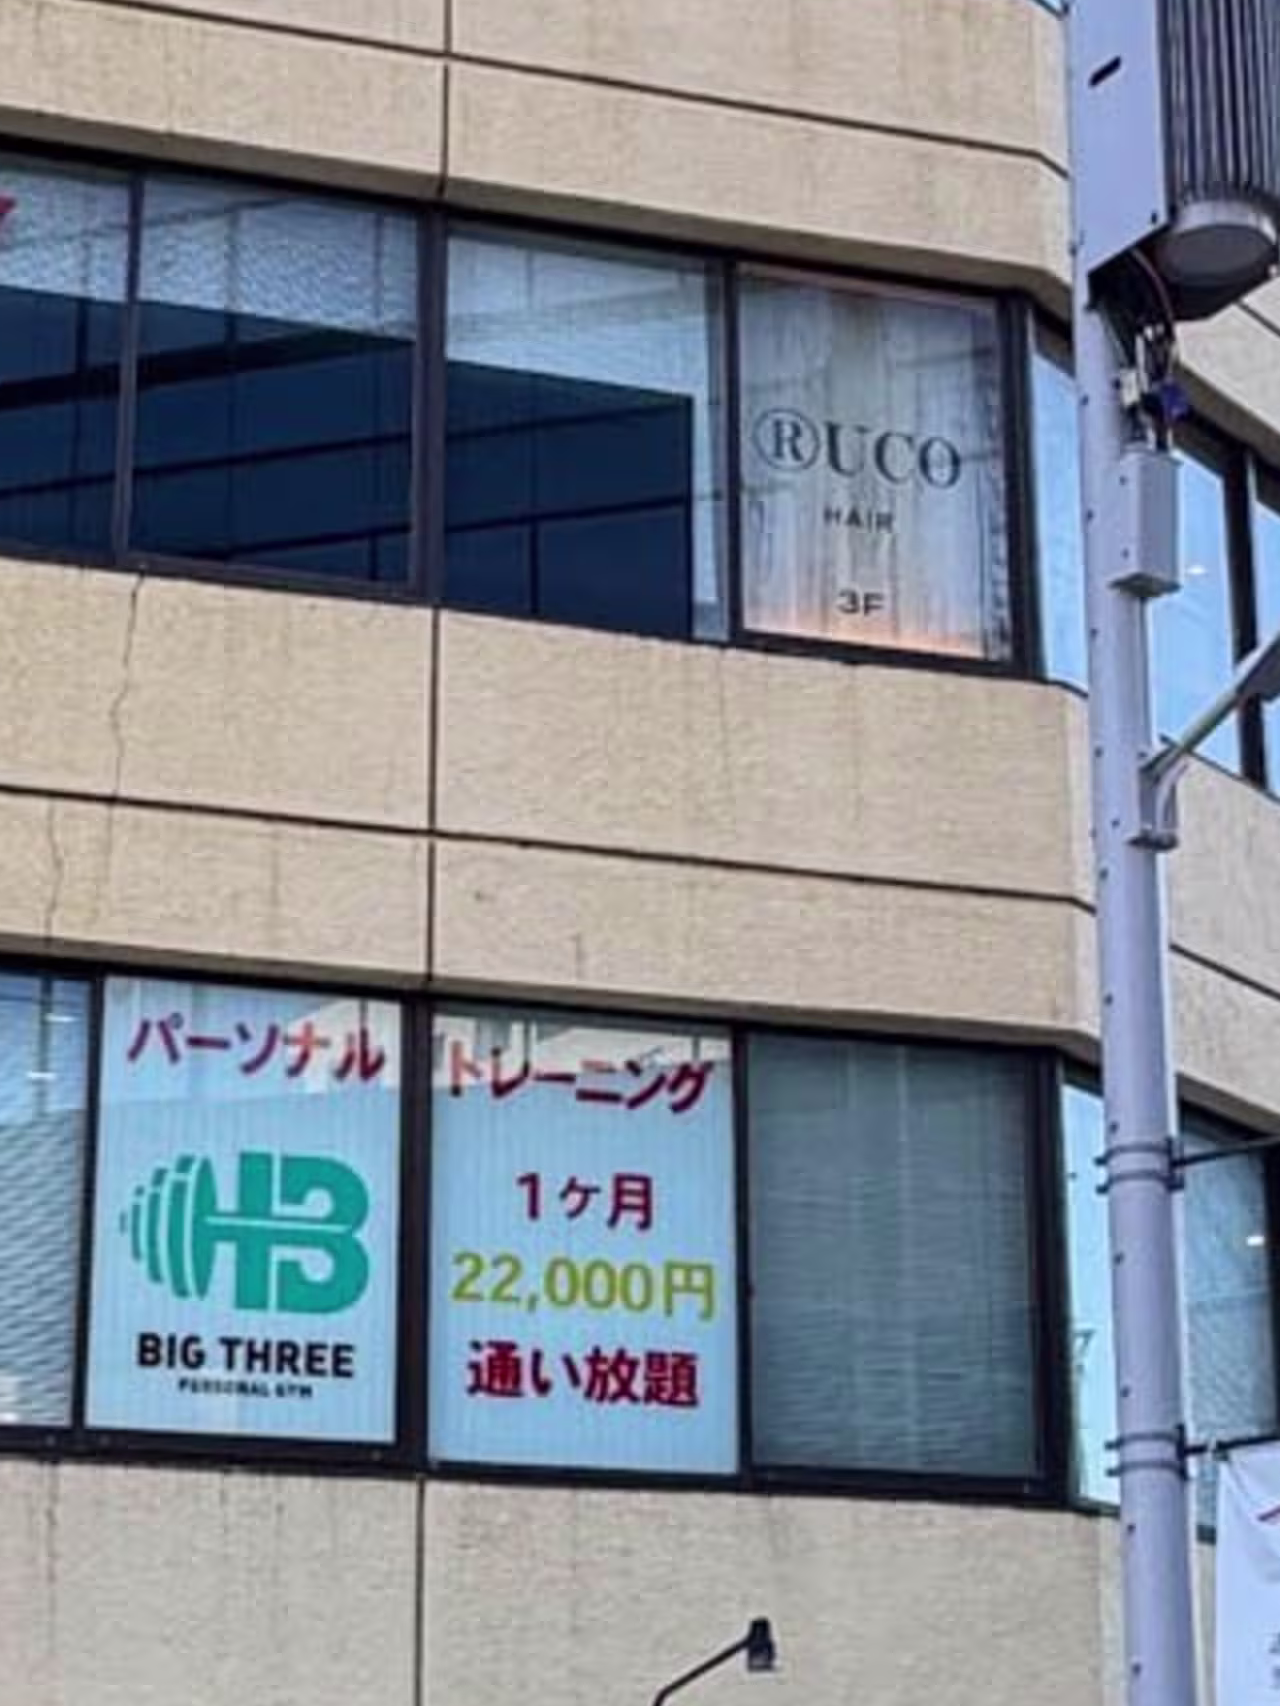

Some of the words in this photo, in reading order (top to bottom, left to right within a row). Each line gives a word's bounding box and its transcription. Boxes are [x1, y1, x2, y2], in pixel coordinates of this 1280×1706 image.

[823, 505, 895, 534] HAIR
[837, 589, 885, 617] 3F
[127, 1011, 386, 1081] パーソナル
[449, 1041, 715, 1114] トレーニング
[451, 1251, 715, 1321] 22,000円
[136, 1331, 207, 1371] BIG
[218, 1336, 356, 1379] THREE
[466, 1340, 699, 1408] 通い放題
